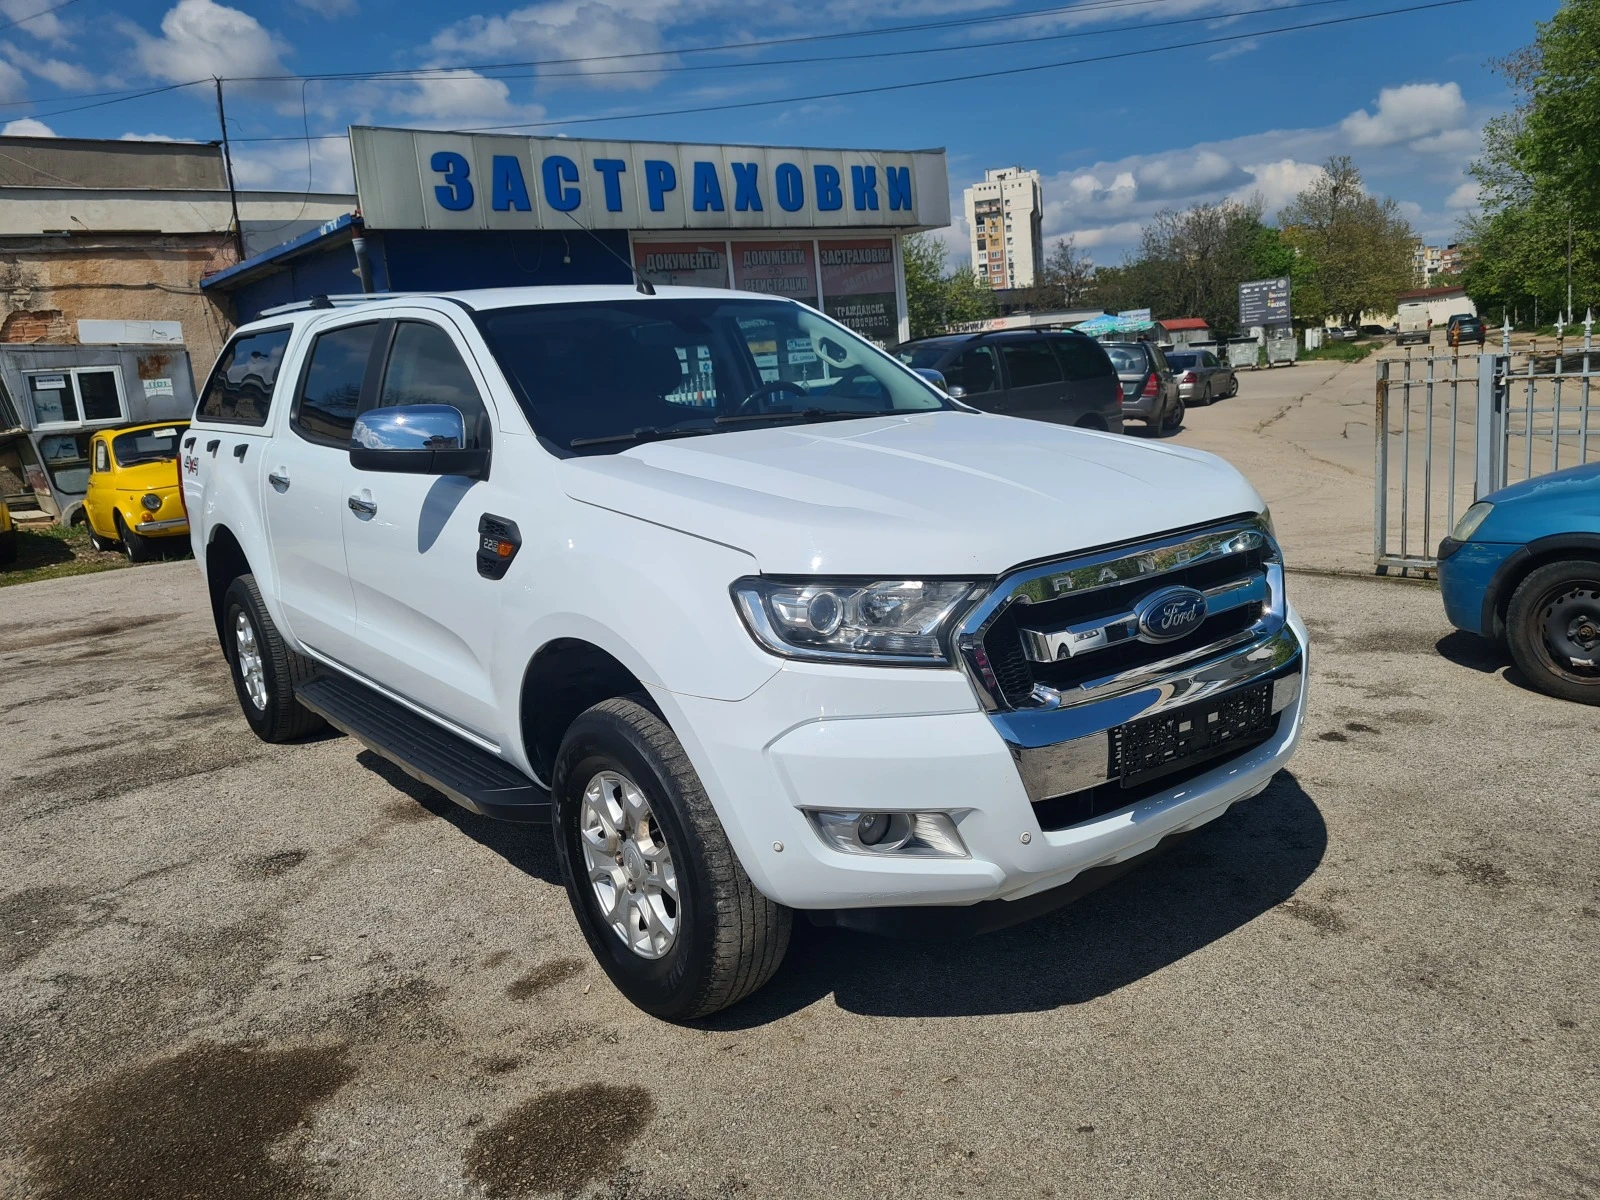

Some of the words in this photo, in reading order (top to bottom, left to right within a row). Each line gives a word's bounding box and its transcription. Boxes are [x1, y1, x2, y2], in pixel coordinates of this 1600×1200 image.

[430, 151, 912, 212] ЗАСТРАХОВКИ
[646, 253, 720, 272] ДОКУМЕНТИ
[743, 250, 805, 267] ДОКУМЕНТИ
[821, 248, 891, 265] ЗАСТРАХОВКИ
[745, 277, 808, 293] РЕГИСТРАЦИЯ
[1053, 531, 1251, 592] RANGER
[1161, 601, 1197, 629] Ford
